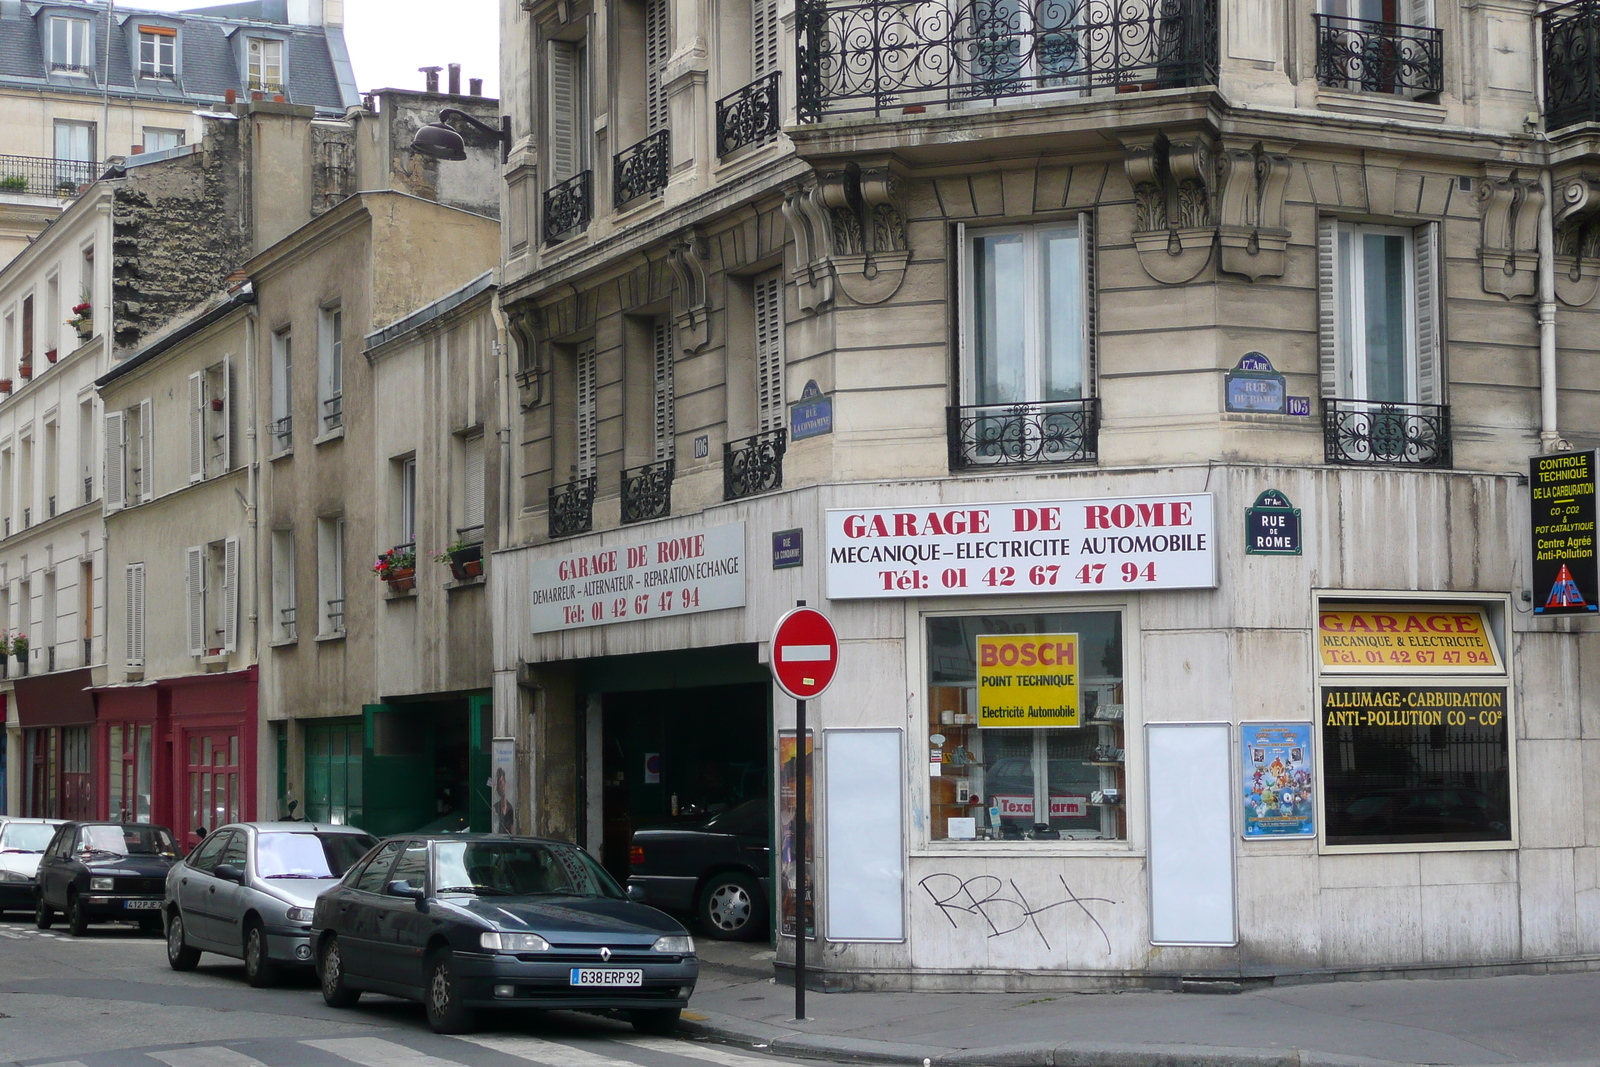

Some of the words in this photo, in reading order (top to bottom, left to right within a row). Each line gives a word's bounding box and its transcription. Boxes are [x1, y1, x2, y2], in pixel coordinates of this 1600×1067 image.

[1245, 382, 1267, 392] RUE
[1234, 394, 1246, 403] DE
[1249, 394, 1278, 404] ROME
[805, 407, 817, 418] RUE
[695, 438, 707, 457] 106
[1540, 455, 1586, 470] CONTROLE
[1538, 467, 1588, 482] TECHNIQUE
[1533, 487, 1542, 499] DE
[1543, 486, 1551, 498] LA
[1552, 482, 1594, 497] CARBURATION
[1550, 507, 1561, 516] CO
[1565, 505, 1580, 515] CO2
[842, 509, 991, 539] GARAGE
[1012, 507, 1061, 533] DE
[1084, 501, 1193, 530] ROME
[1261, 515, 1286, 527] RUE
[1562, 515, 1568, 523] &
[1535, 525, 1550, 534] POT
[1550, 522, 1594, 533] CATALYTIQUE
[782, 537, 791, 547] RUE
[1080, 533, 1207, 556] AUTOMOBILE
[1257, 536, 1292, 548] ROME
[1537, 538, 1565, 549] Centre
[1567, 534, 1592, 549] Agréé
[558, 550, 618, 581] GARAGE
[626, 545, 648, 569] DE
[657, 534, 705, 564] ROME
[1537, 548, 1593, 560] Anti-Pollution
[533, 584, 576, 605] DEMARREUR
[583, 574, 634, 597] ALTERNATEUR
[644, 564, 695, 588] REPARATION
[697, 556, 739, 580] ECHANGE
[878, 569, 930, 592] Tél:
[941, 567, 969, 589] 01
[981, 565, 1017, 588] 42
[1028, 564, 1062, 586] 67
[1074, 562, 1107, 585] 47
[1120, 561, 1157, 583] 94
[563, 604, 585, 624] Tél:
[591, 601, 604, 621] 01
[611, 597, 627, 618] 42
[634, 594, 650, 615] 67
[658, 590, 673, 612] 47
[682, 586, 700, 609] 94
[1319, 614, 1478, 634] GARAGE
[1323, 636, 1393, 648] MECANIQUE
[1397, 637, 1406, 647] &
[1409, 636, 1484, 647] ELECTRICITE
[981, 642, 1075, 667] BOSCH
[1326, 650, 1361, 663] Tél.
[1365, 651, 1385, 663] 01
[1389, 651, 1411, 663] 42
[1415, 651, 1436, 663] 67
[1442, 651, 1462, 663] 47
[1466, 651, 1490, 663] 94
[981, 675, 1012, 687] POINT
[1016, 674, 1075, 686] TECHNIQUE
[982, 705, 1025, 719] Electricité
[1028, 704, 1075, 718] Automobile
[1326, 710, 1442, 726] ANTI-POLLUTION
[1447, 711, 1466, 725] CO
[1001, 799, 1034, 812] Texa
